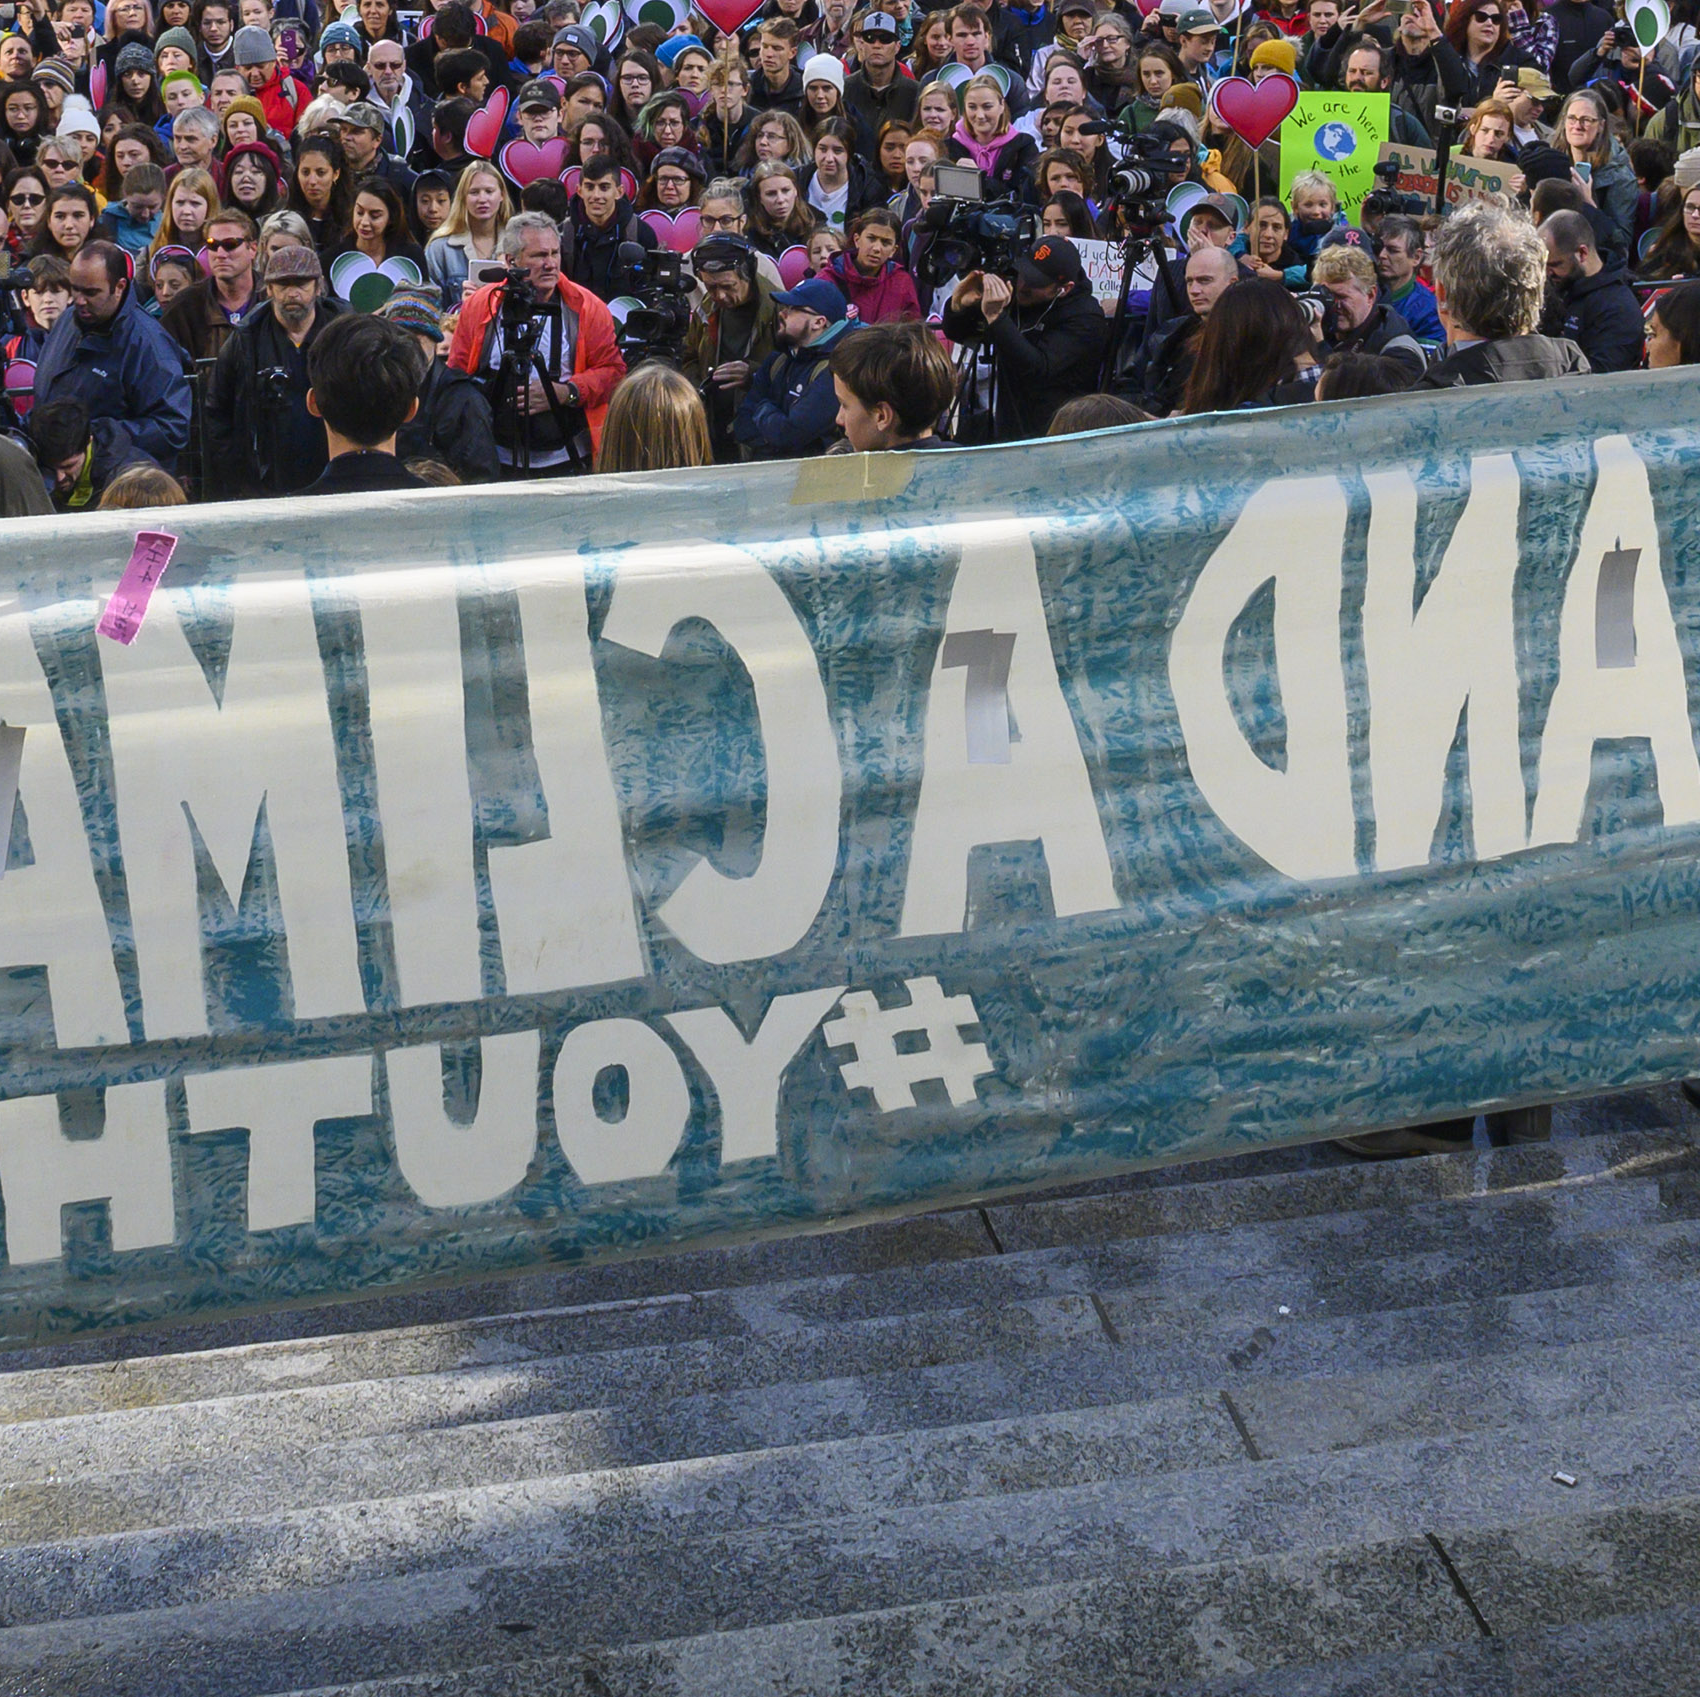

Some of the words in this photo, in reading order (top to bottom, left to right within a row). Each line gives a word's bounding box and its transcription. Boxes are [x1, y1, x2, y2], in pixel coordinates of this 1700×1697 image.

[1289, 105, 1316, 129] We
[1323, 101, 1351, 114] are
[1357, 105, 1379, 142] here
[1337, 162, 1361, 178] the
